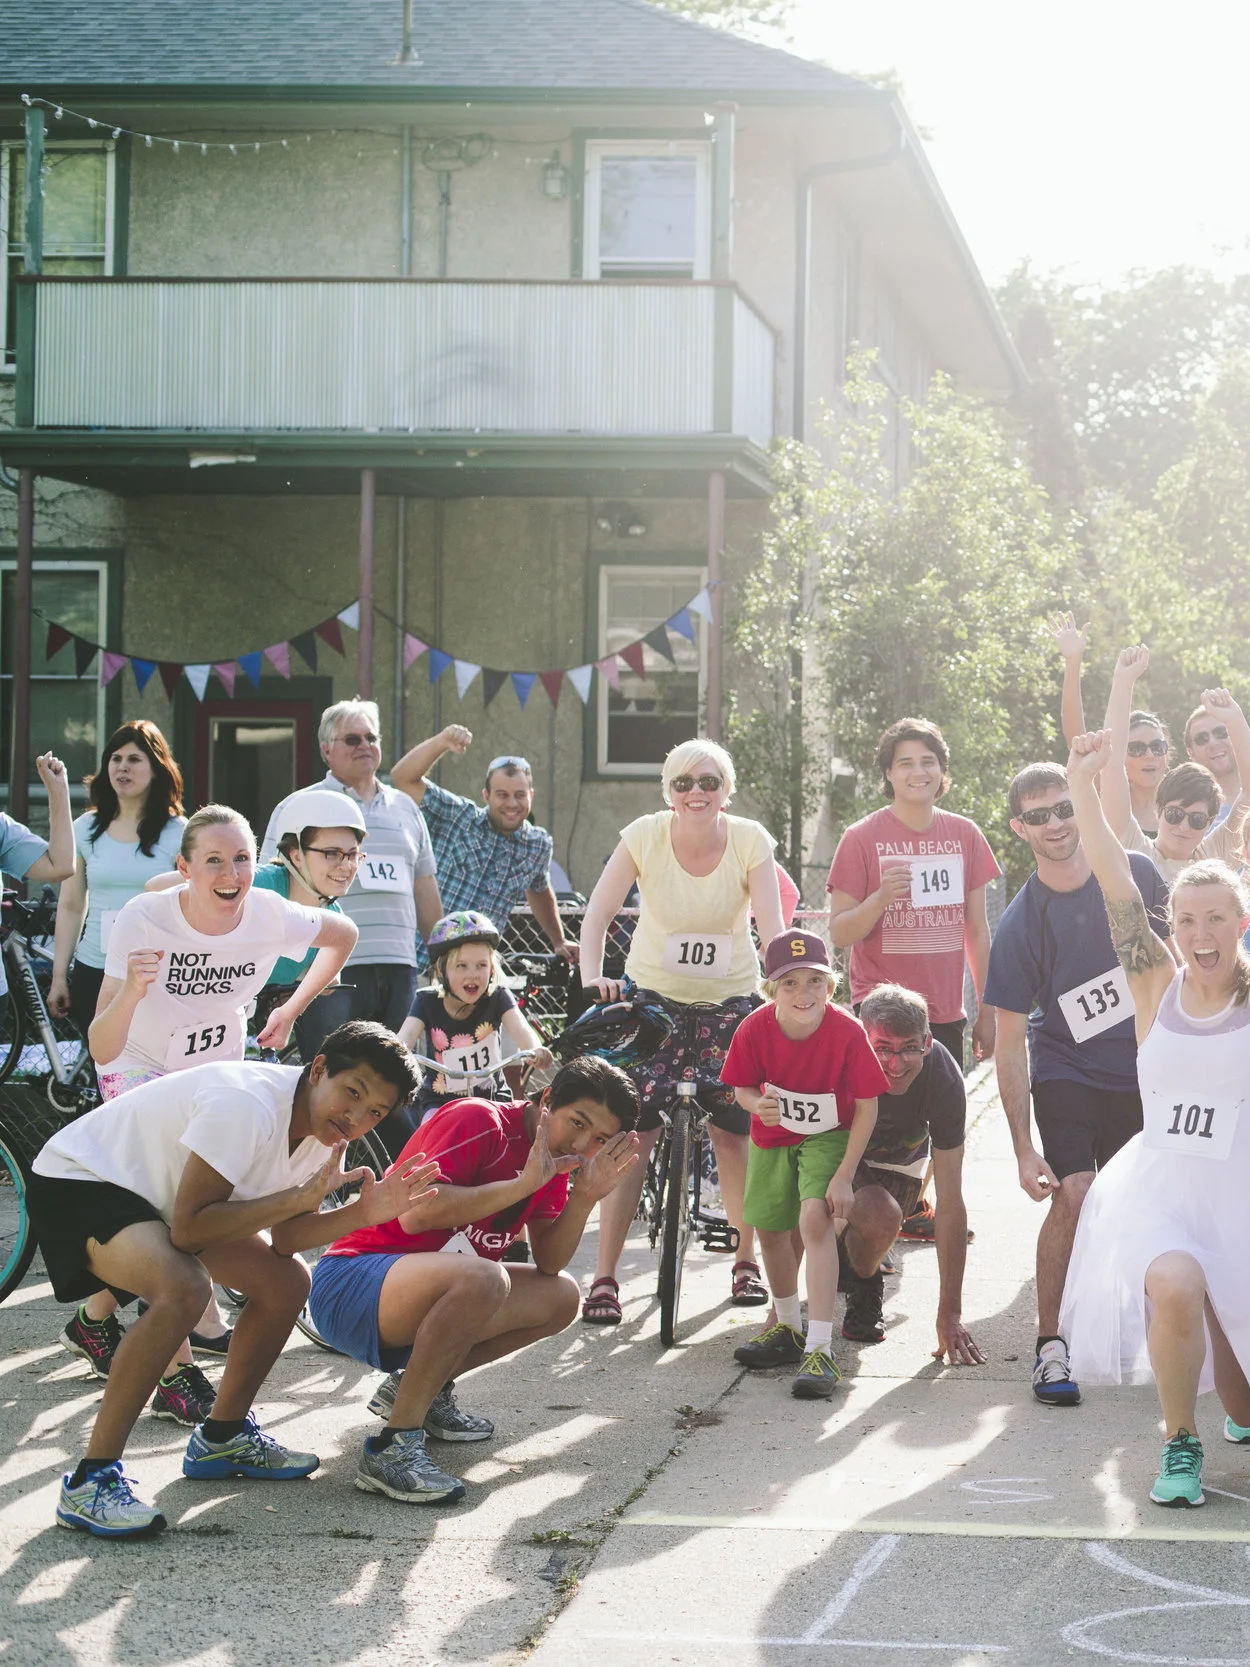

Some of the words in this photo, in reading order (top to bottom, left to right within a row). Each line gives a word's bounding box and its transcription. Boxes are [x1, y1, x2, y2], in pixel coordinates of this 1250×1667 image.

[876, 841, 914, 855] PALM
[919, 840, 962, 854] BEACH
[366, 862, 397, 880] 142
[921, 869, 950, 893] 149
[882, 909, 964, 928] AUSTRALIA
[170, 952, 212, 966] NOT
[677, 941, 717, 966] 103
[790, 939, 807, 957] S
[167, 962, 256, 982] RUNNING
[165, 981, 234, 996] SUCKS.
[1076, 980, 1120, 1022] 135
[184, 1024, 227, 1056] 153
[459, 1046, 490, 1072] 113
[780, 1098, 821, 1123] 152
[1167, 1103, 1215, 1138] 101
